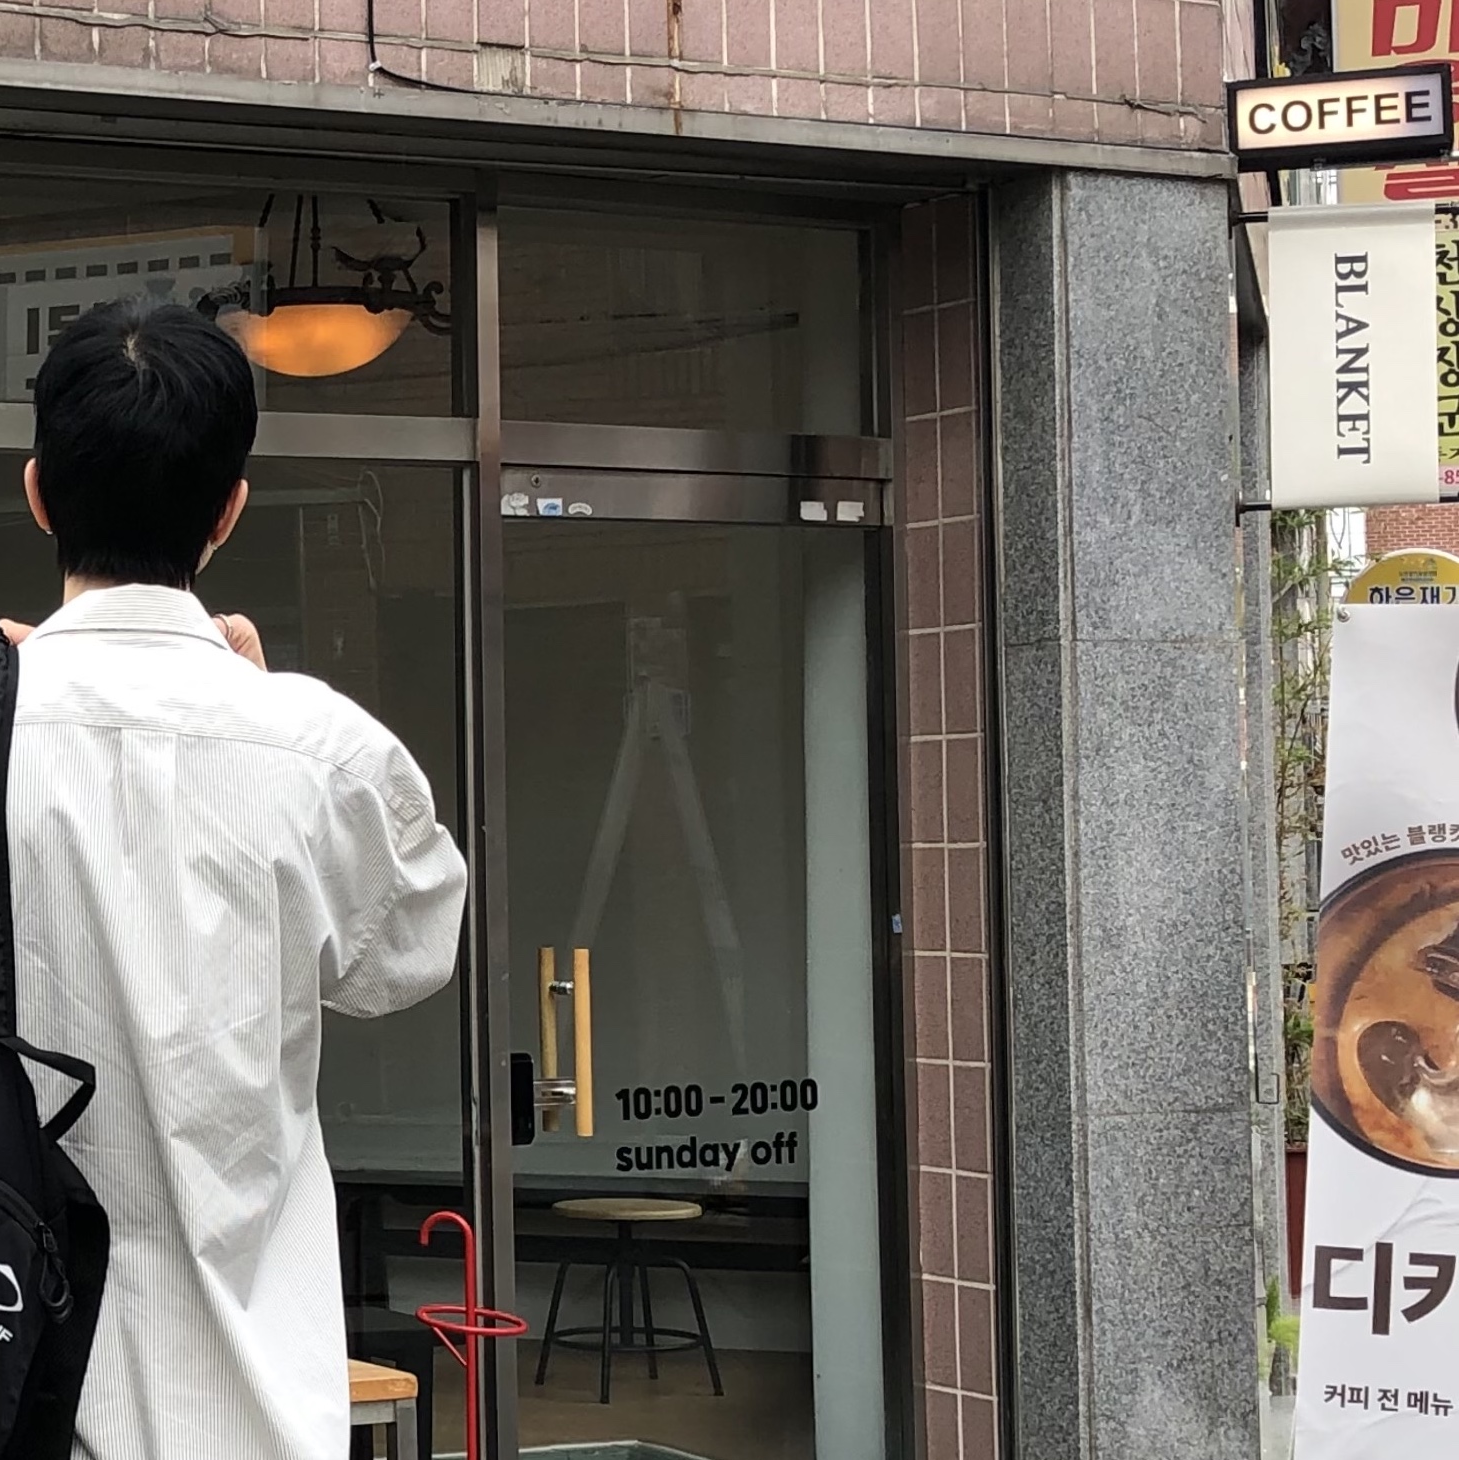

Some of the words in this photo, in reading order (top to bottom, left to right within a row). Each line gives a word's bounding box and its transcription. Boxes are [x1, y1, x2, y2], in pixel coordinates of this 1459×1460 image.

[1248, 90, 1432, 135] COFFEE
[1333, 250, 1371, 465] BLANKET
[1341, 832, 1402, 866] 맛있는
[615, 1136, 742, 1172] sunday
[750, 1131, 798, 1166] off
[1324, 1384, 1369, 1410] 커피
[1377, 1387, 1399, 1413] 전
[1407, 1390, 1454, 1417] 메뉴
